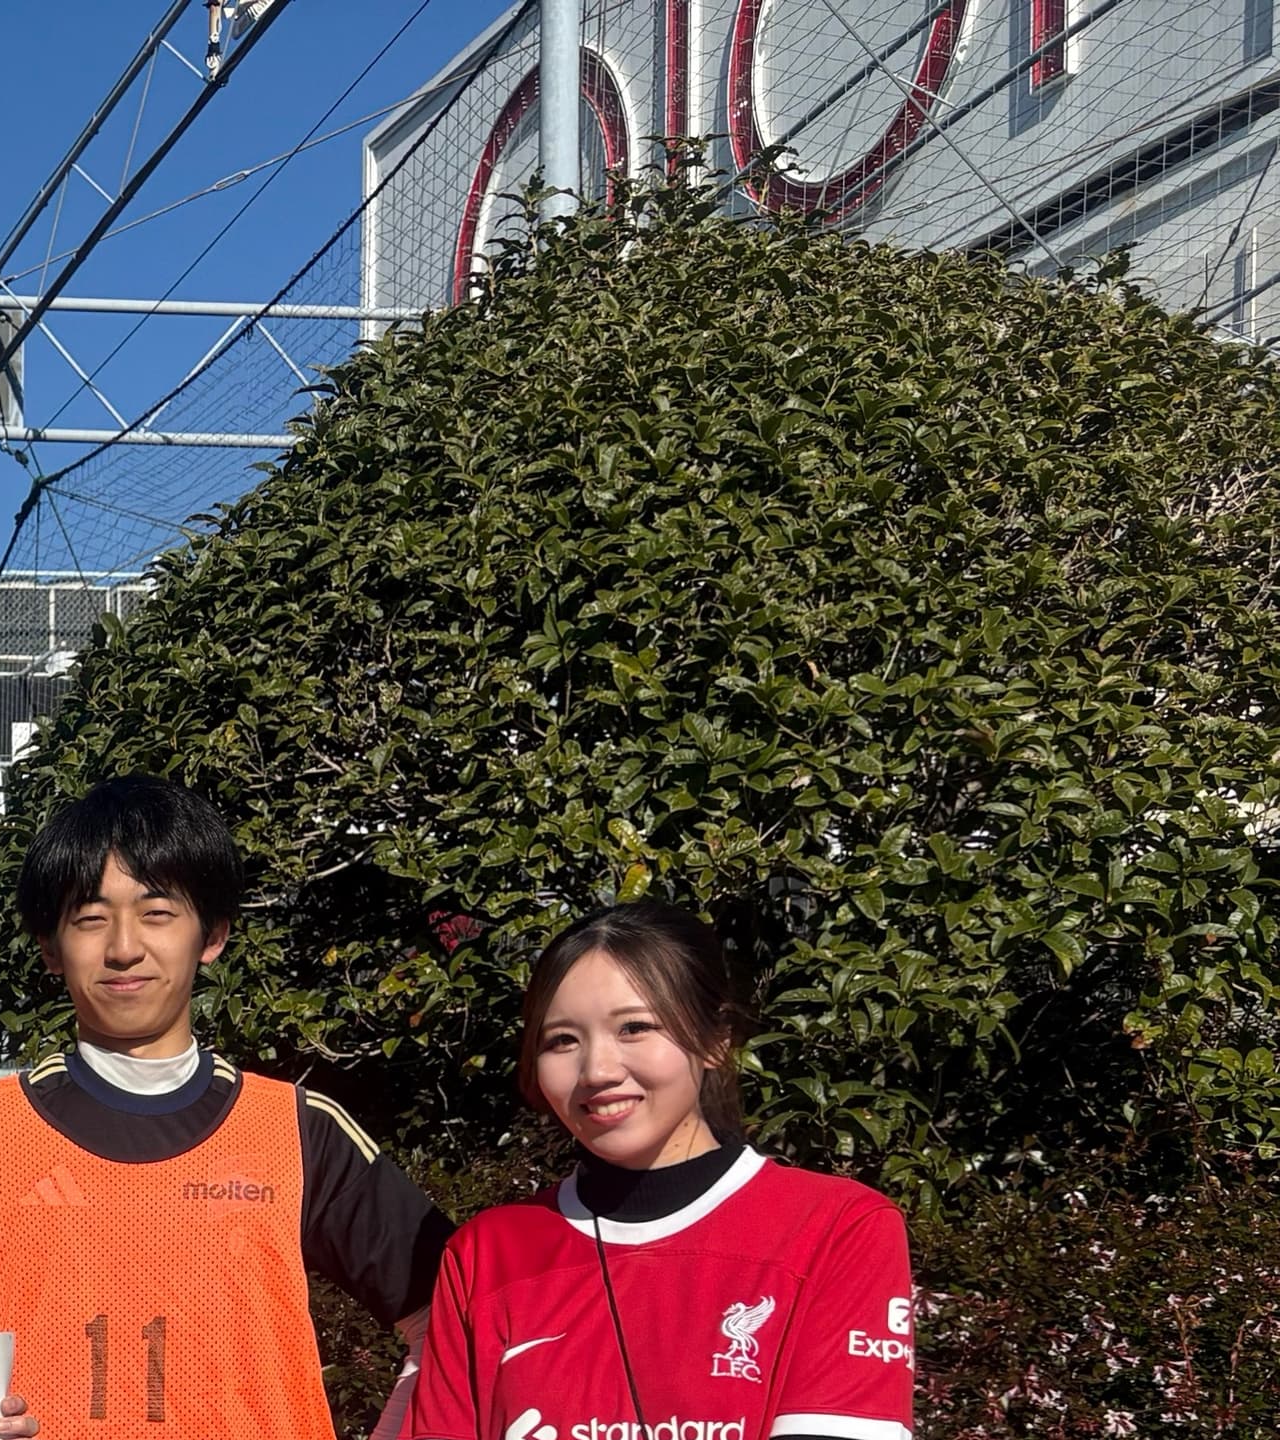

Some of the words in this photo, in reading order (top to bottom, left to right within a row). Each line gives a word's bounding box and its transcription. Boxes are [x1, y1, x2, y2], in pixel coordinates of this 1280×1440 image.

[182, 1180, 275, 1204] molten
[84, 1313, 167, 1423] 11
[848, 1329, 915, 1372] Exp
